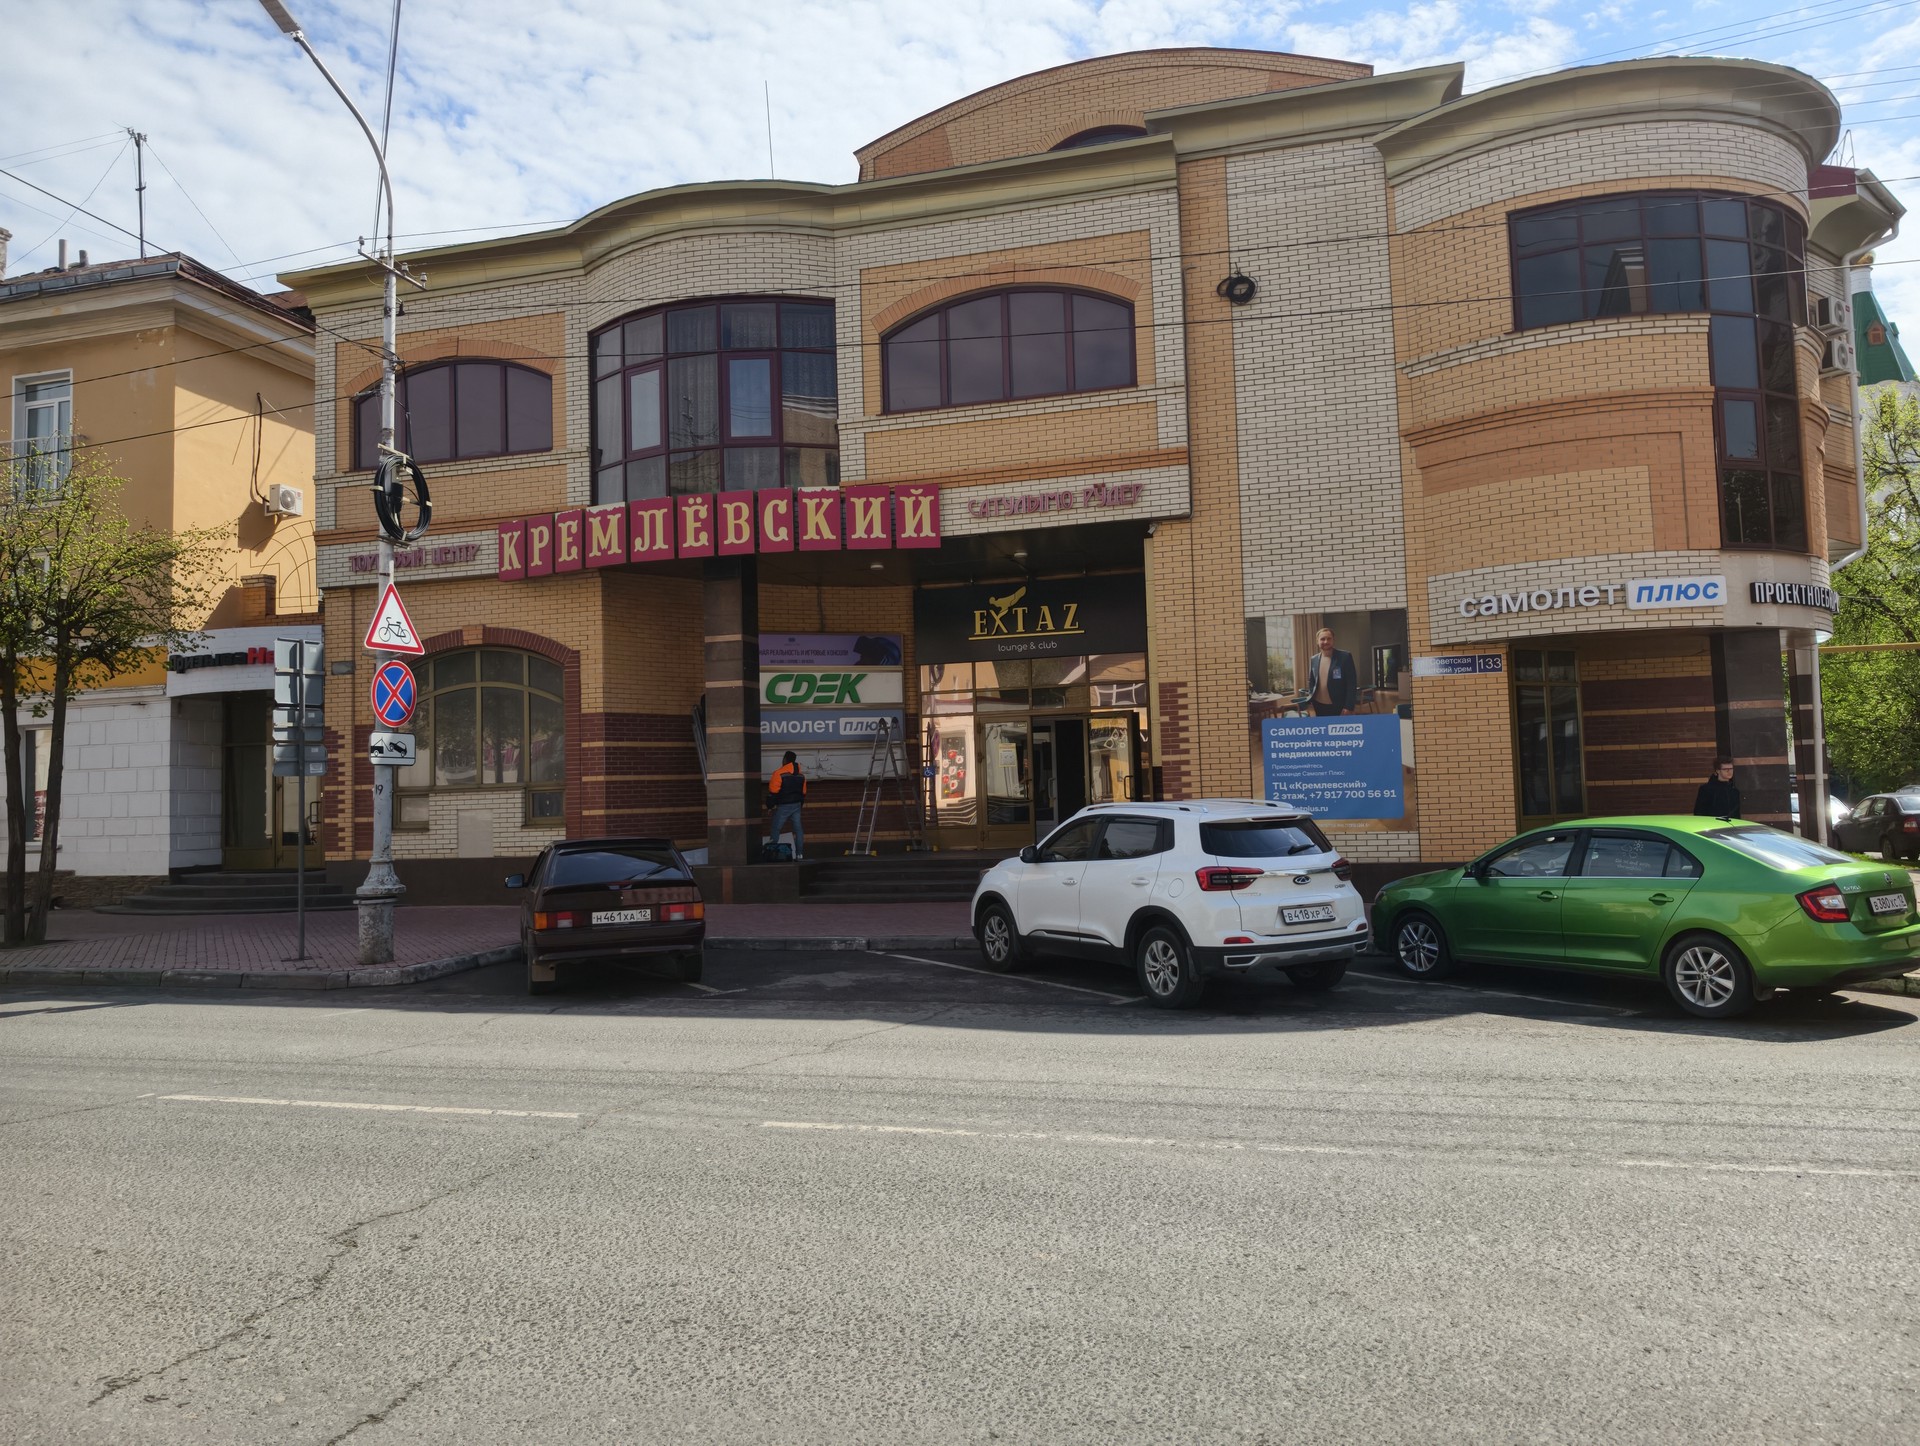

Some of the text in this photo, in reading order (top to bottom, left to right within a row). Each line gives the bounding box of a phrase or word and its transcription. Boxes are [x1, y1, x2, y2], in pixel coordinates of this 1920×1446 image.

[501, 487, 937, 572] КРЕМЛЁВСКИЙ
[1459, 583, 1622, 618] самолет
[973, 603, 1080, 637] EXTAZ
[998, 640, 1057, 653] lounge & club
[1478, 657, 1502, 670] 133
[1454, 666, 1472, 674] урем
[760, 719, 836, 733] амолет
[1270, 726, 1326, 736] самолет
[1271, 739, 1364, 750] Постройте карьеру
[1279, 750, 1352, 759] недвижимости
[1272, 780, 1367, 791] ТЦ «Кремлевский»
[1273, 789, 1396, 801] 2 этаж, +7 917 700 56 91
